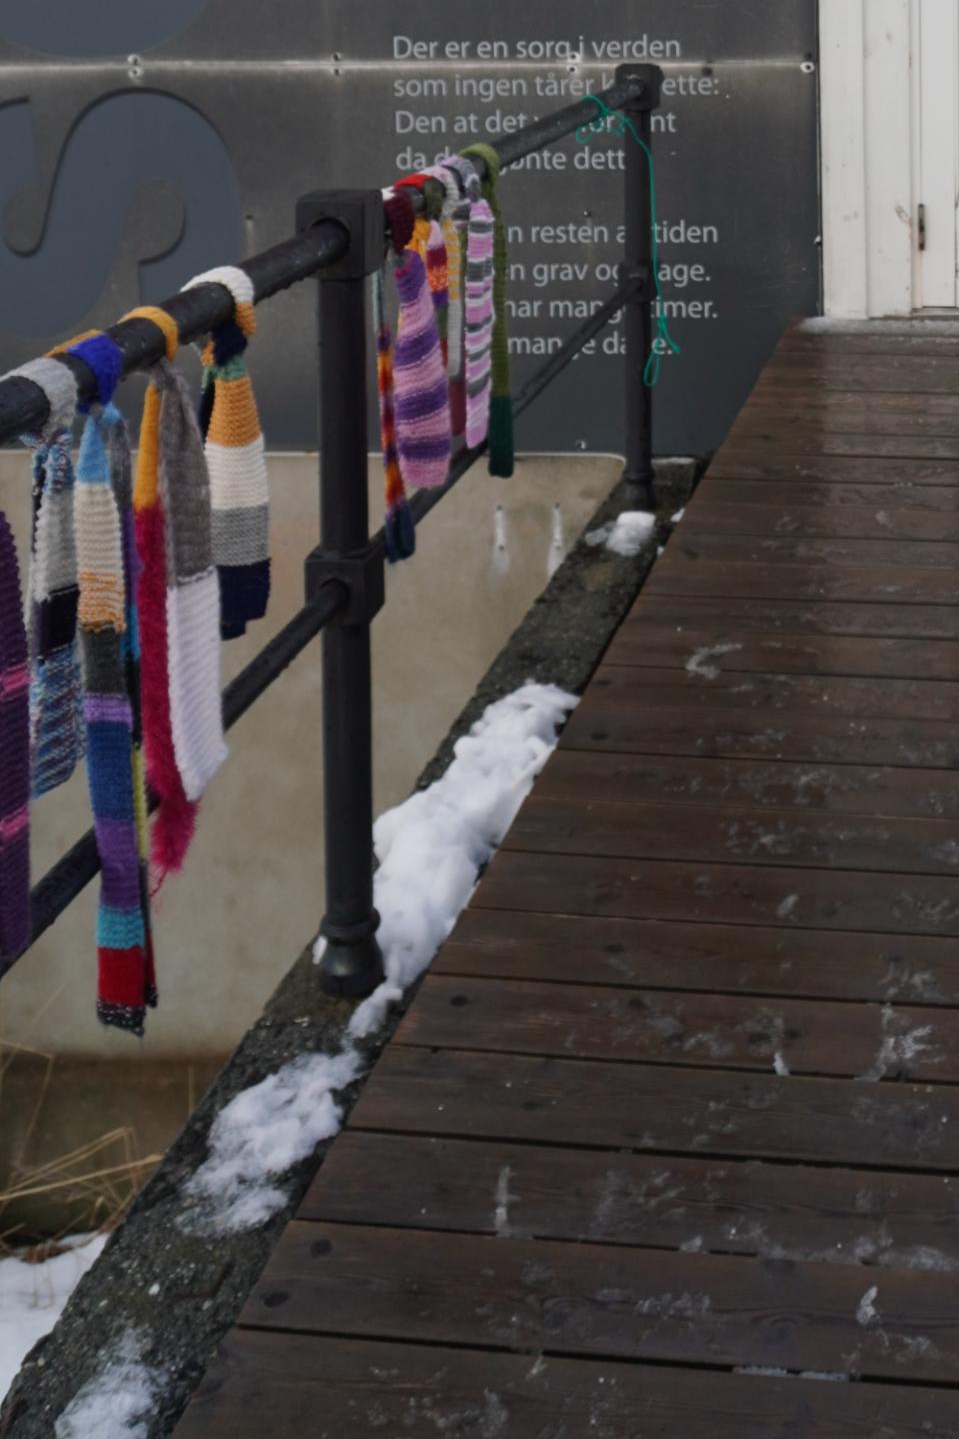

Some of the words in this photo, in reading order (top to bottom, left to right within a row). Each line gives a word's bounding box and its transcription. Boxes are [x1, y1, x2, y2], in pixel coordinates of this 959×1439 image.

[392, 35, 438, 59] Der
[444, 40, 471, 59] er
[476, 40, 508, 59] en
[591, 34, 681, 58] verden
[393, 78, 447, 97] som
[455, 74, 527, 102] ingen
[534, 72, 595, 96] tårer
[661, 75, 719, 96] ette:
[395, 111, 446, 134] Den
[453, 113, 477, 133] at
[485, 110, 527, 133] det
[395, 146, 427, 170] da
[573, 146, 625, 170] dett
[531, 223, 608, 243] resten
[651, 219, 718, 243] tiden
[533, 263, 588, 287] grav
[658, 264, 711, 287] age.
[651, 296, 717, 318] imer.
[507, 337, 596, 360] mane
